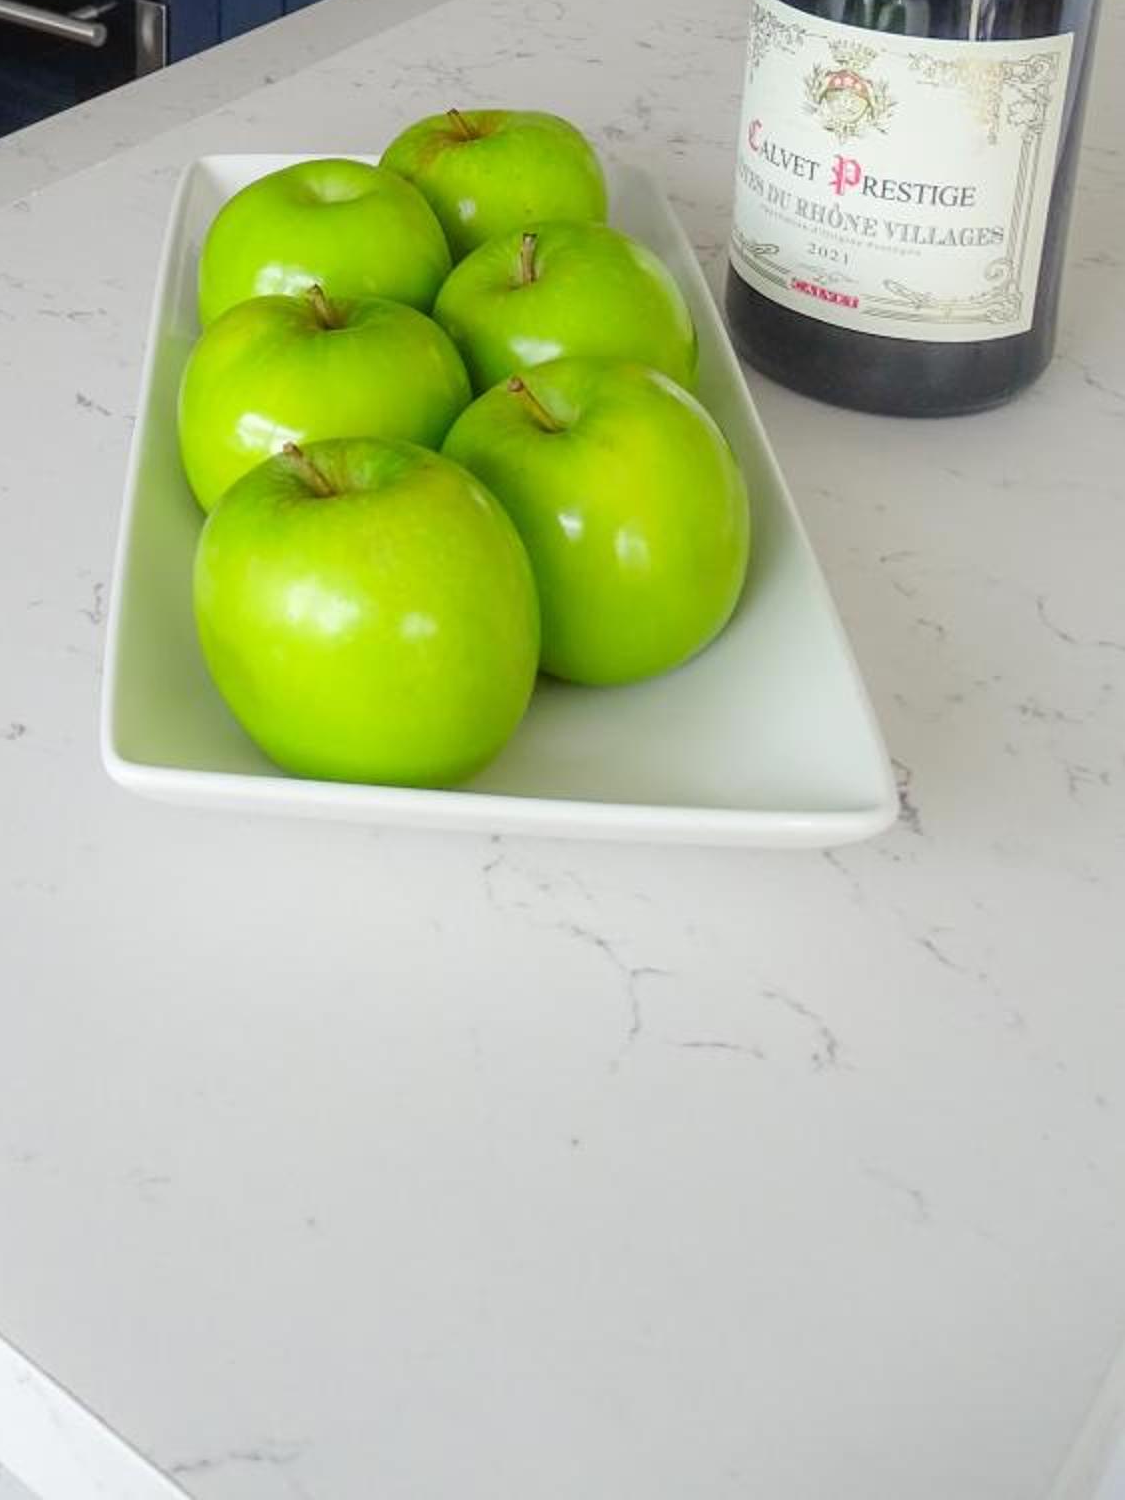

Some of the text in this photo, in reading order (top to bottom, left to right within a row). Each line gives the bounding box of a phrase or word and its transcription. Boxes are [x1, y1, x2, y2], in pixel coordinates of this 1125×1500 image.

[747, 118, 977, 208] CALVET PRESTIGE
[767, 183, 793, 210] DU
[795, 200, 878, 238] RHÔNE
[883, 218, 1004, 248] VILLAGES
